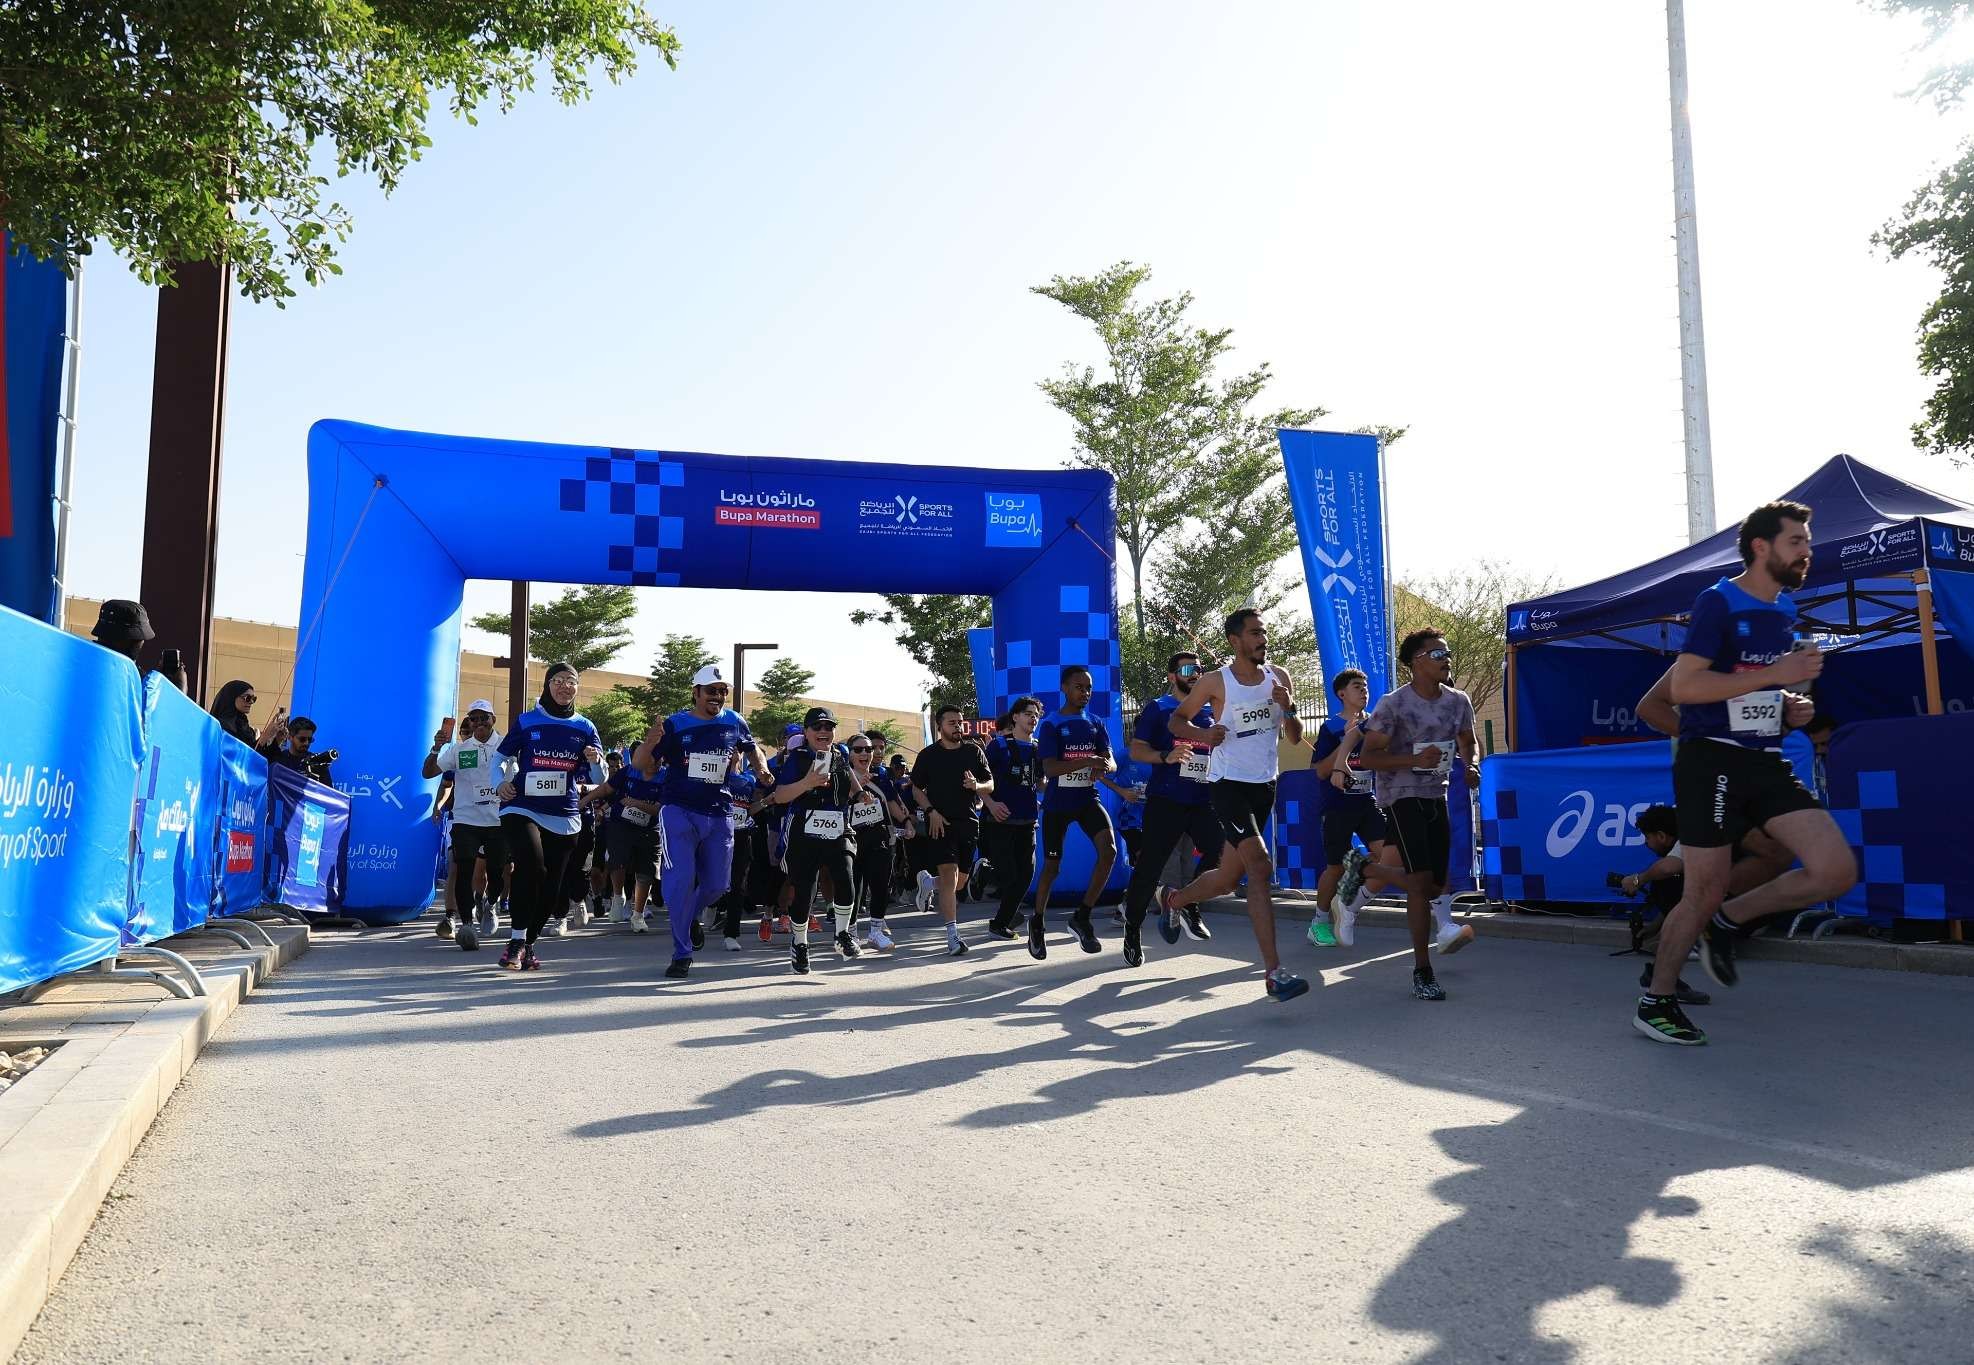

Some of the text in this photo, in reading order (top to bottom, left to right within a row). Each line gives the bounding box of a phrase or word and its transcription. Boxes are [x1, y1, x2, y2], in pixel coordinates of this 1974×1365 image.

[720, 489, 815, 508] ماراثون بوبا
[989, 495, 1025, 511] بوبا
[1315, 468, 1332, 543] SPORTS
[919, 503, 953, 511] SPORTS
[1325, 469, 1340, 545] FOR ALL
[720, 509, 816, 524] Bupa Marathon
[990, 512, 1026, 527] Bupa
[1888, 529, 1916, 541] SPORTS
[1902, 535, 1916, 543] ALL
[1960, 548, 1974, 562] Bu
[1366, 569, 1376, 590] FOR
[1530, 620, 1559, 631] Bupa
[1242, 707, 1271, 724] 5998
[1741, 705, 1776, 720] 5392
[700, 762, 718, 773] 5111
[1066, 772, 1088, 781] 5783
[0, 762, 74, 819] وزارة الريا
[536, 780, 557, 790] 5811
[854, 806, 878, 819] 5063
[812, 819, 838, 829] 5766
[14, 826, 33, 860] of
[30, 826, 68, 867] Sport
[369, 859, 397, 872] Sport
